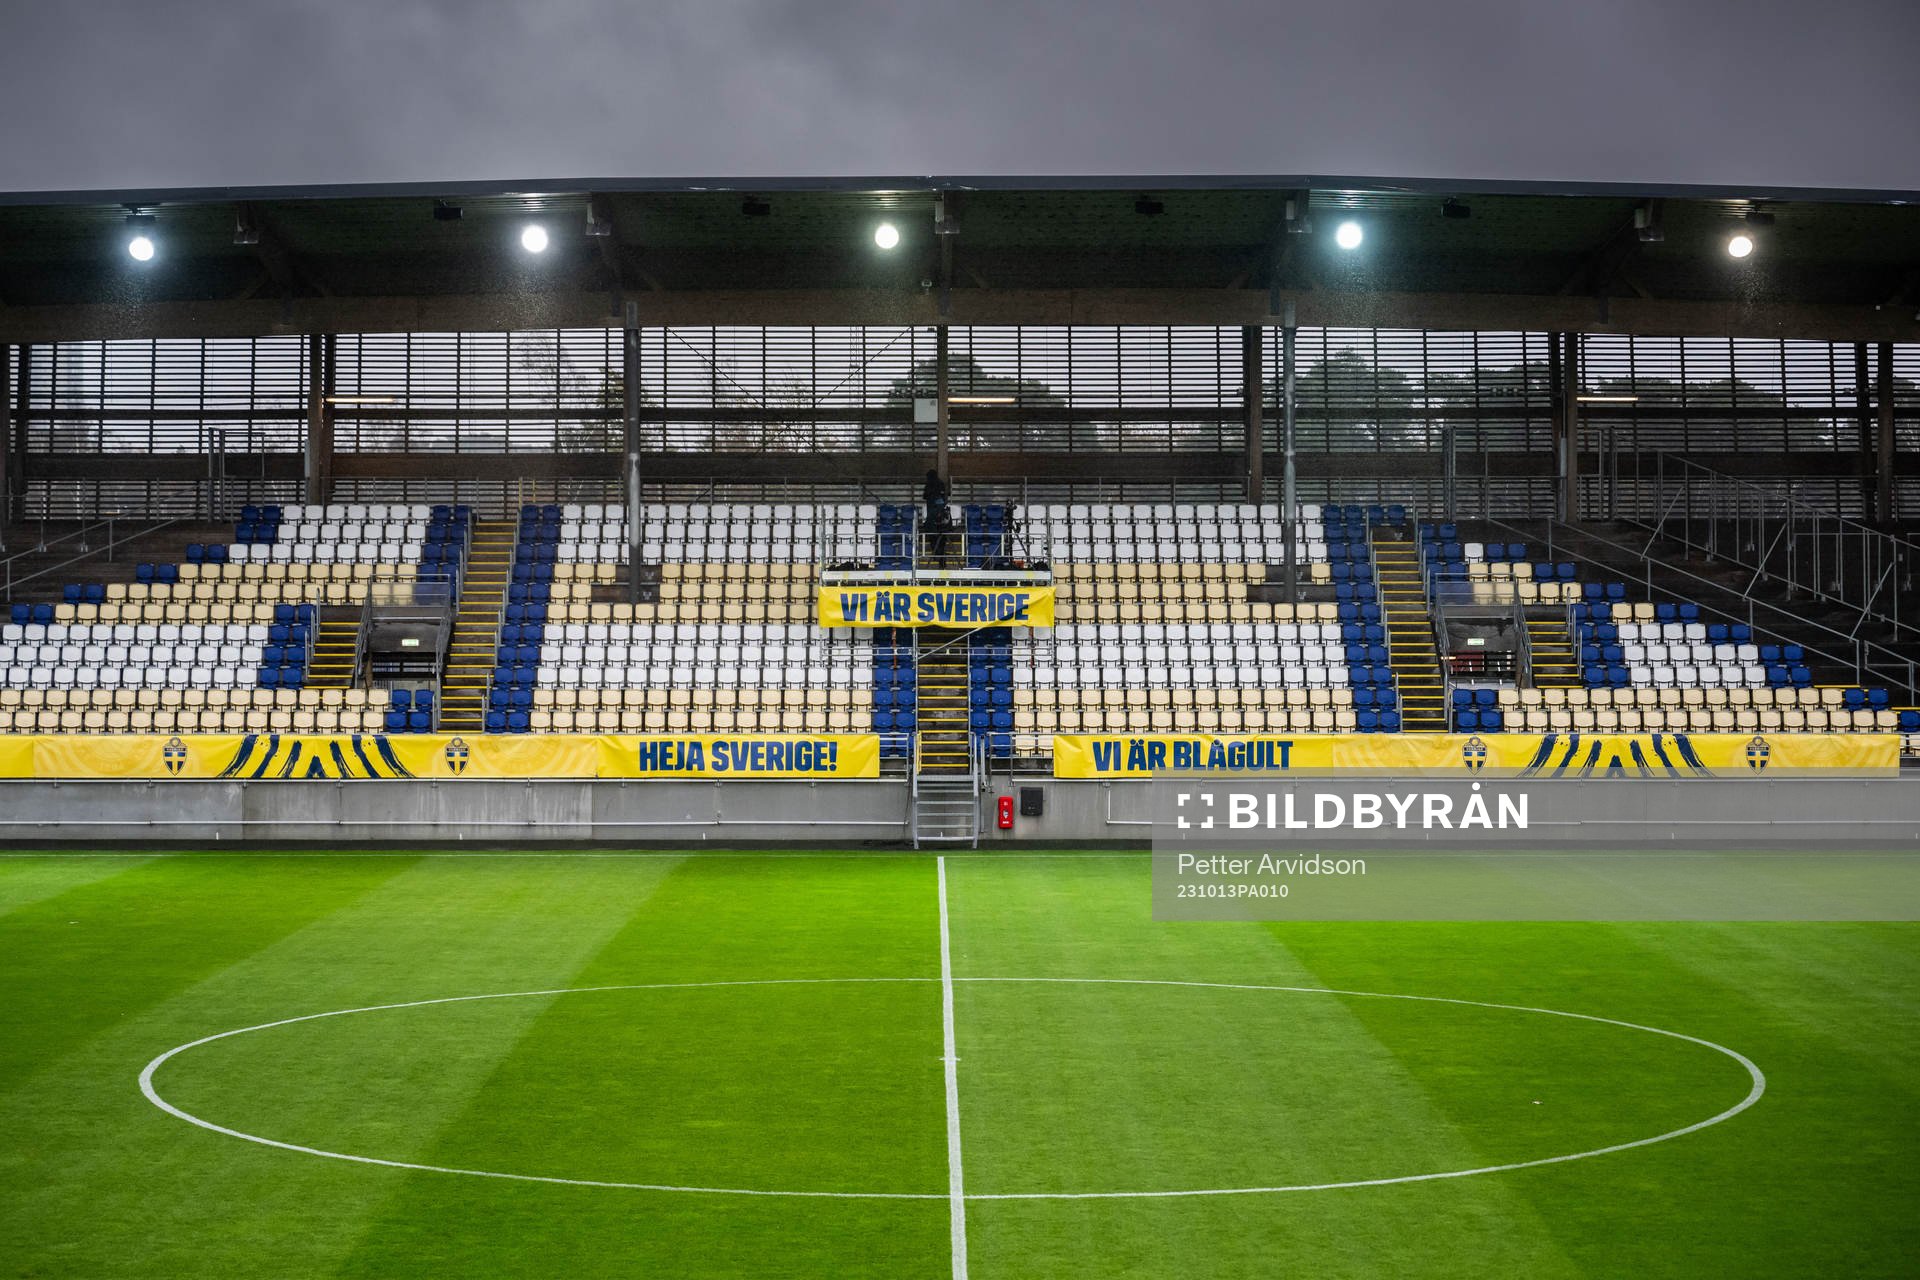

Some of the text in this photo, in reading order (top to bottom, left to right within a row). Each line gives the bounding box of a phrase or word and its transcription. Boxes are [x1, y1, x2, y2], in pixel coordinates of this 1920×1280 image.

[840, 591, 1030, 622] VI ÄR SVERIGE
[639, 741, 838, 771] HEJA SVERIGE!
[1092, 739, 1294, 771] VI ÄR BLÅGULT
